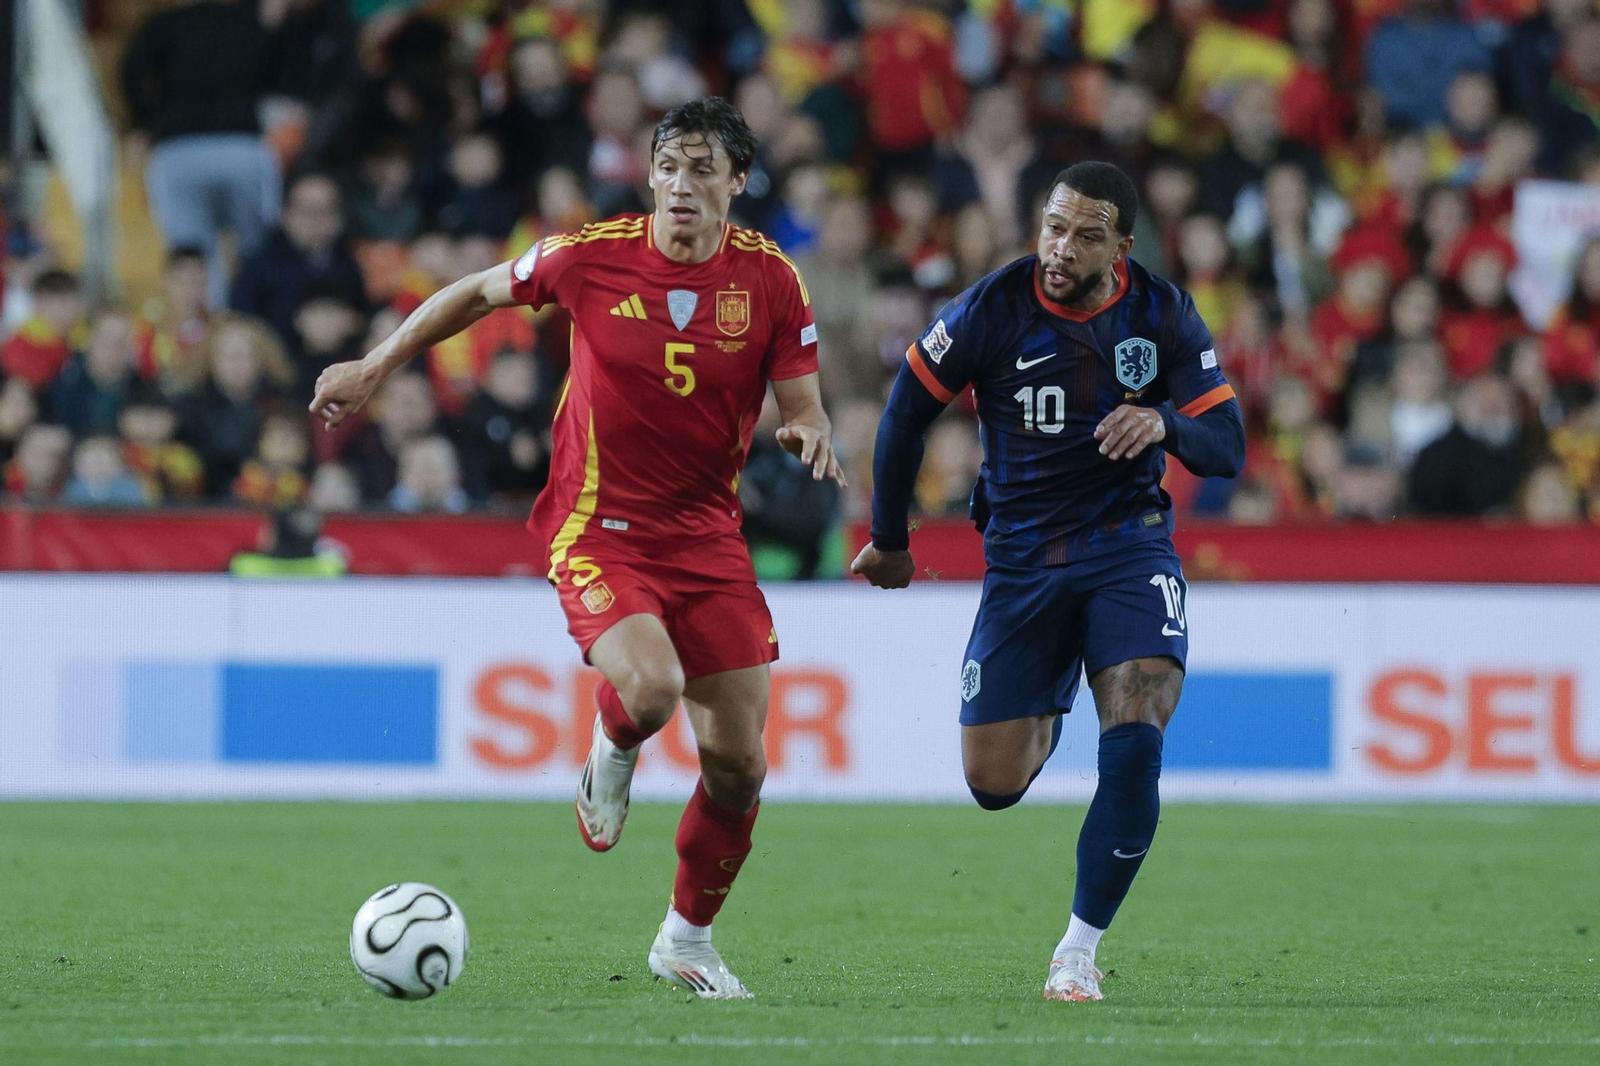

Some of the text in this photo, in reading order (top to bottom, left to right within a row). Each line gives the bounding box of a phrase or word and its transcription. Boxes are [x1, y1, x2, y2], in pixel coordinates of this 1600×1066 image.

[663, 342, 696, 397] 5
[1013, 386, 1065, 434] 10
[568, 556, 602, 587] 5
[1149, 574, 1186, 631] 10
